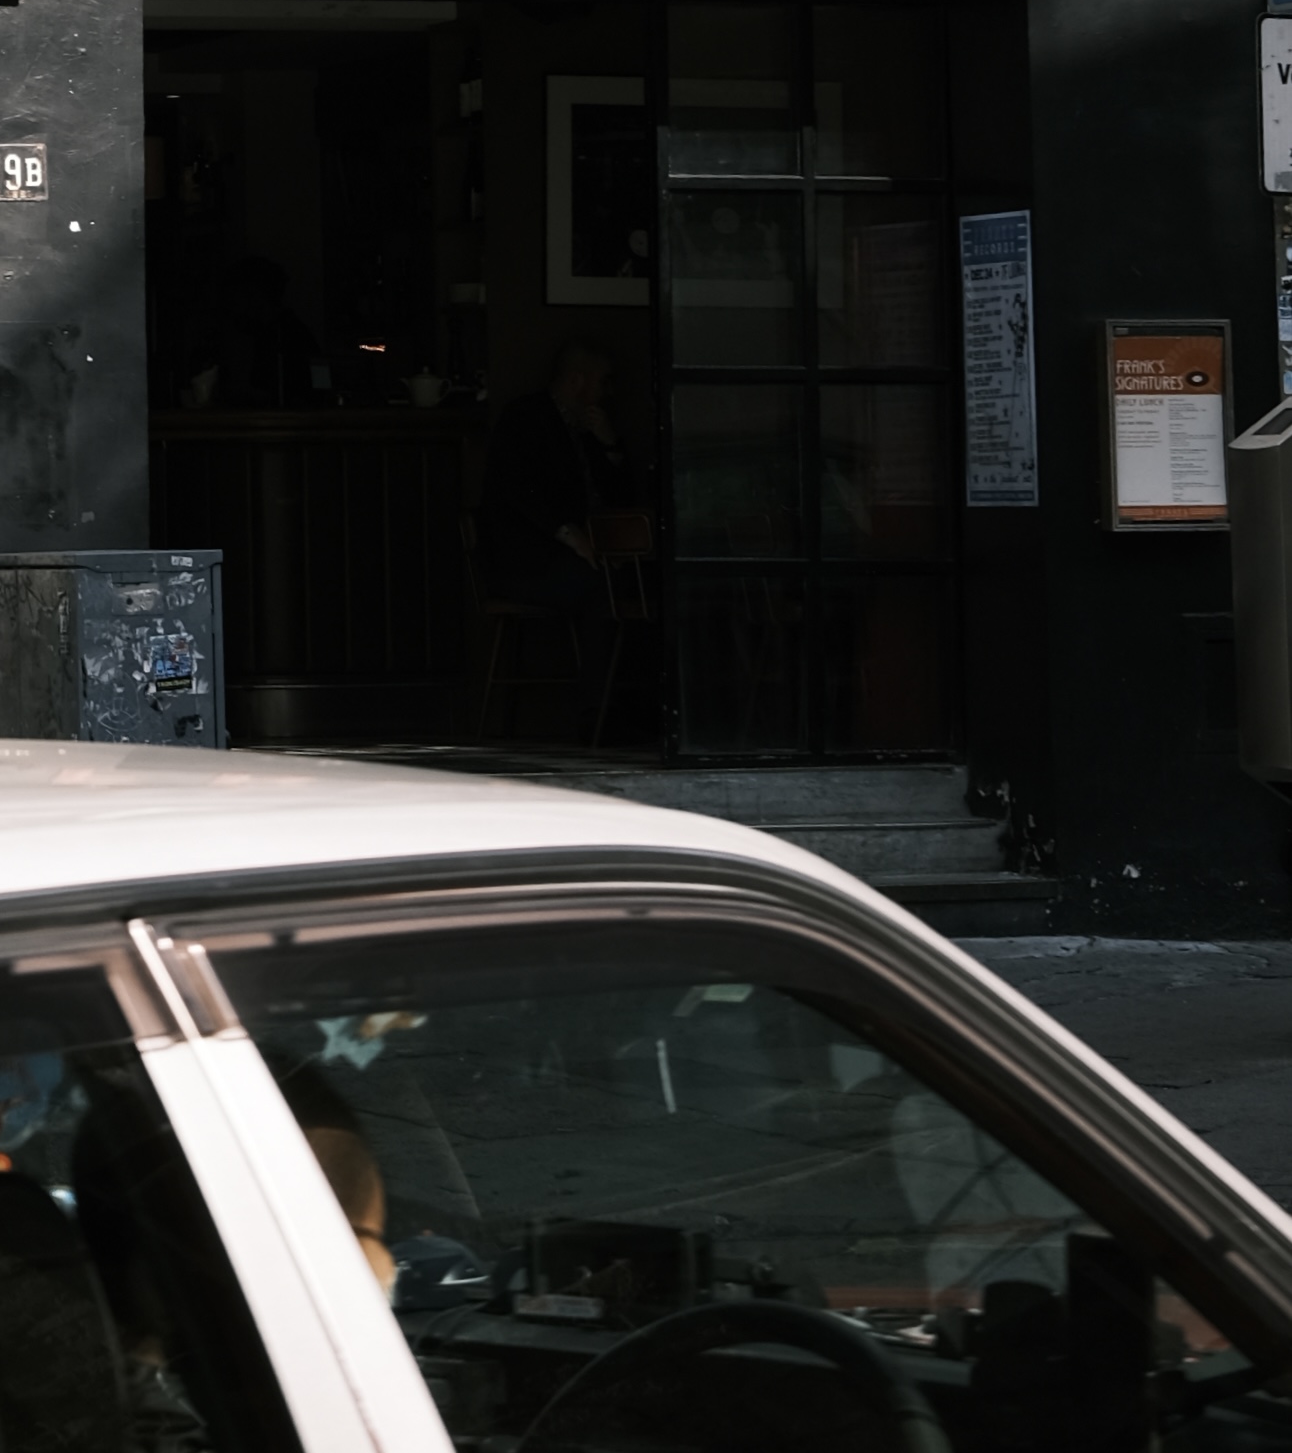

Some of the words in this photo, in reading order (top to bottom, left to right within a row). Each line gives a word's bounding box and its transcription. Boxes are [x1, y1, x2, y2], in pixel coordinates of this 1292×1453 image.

[1116, 359, 1166, 374] FRANK'S
[1115, 375, 1184, 391] SIGNATURES
[1139, 398, 1164, 406] LUNCH
